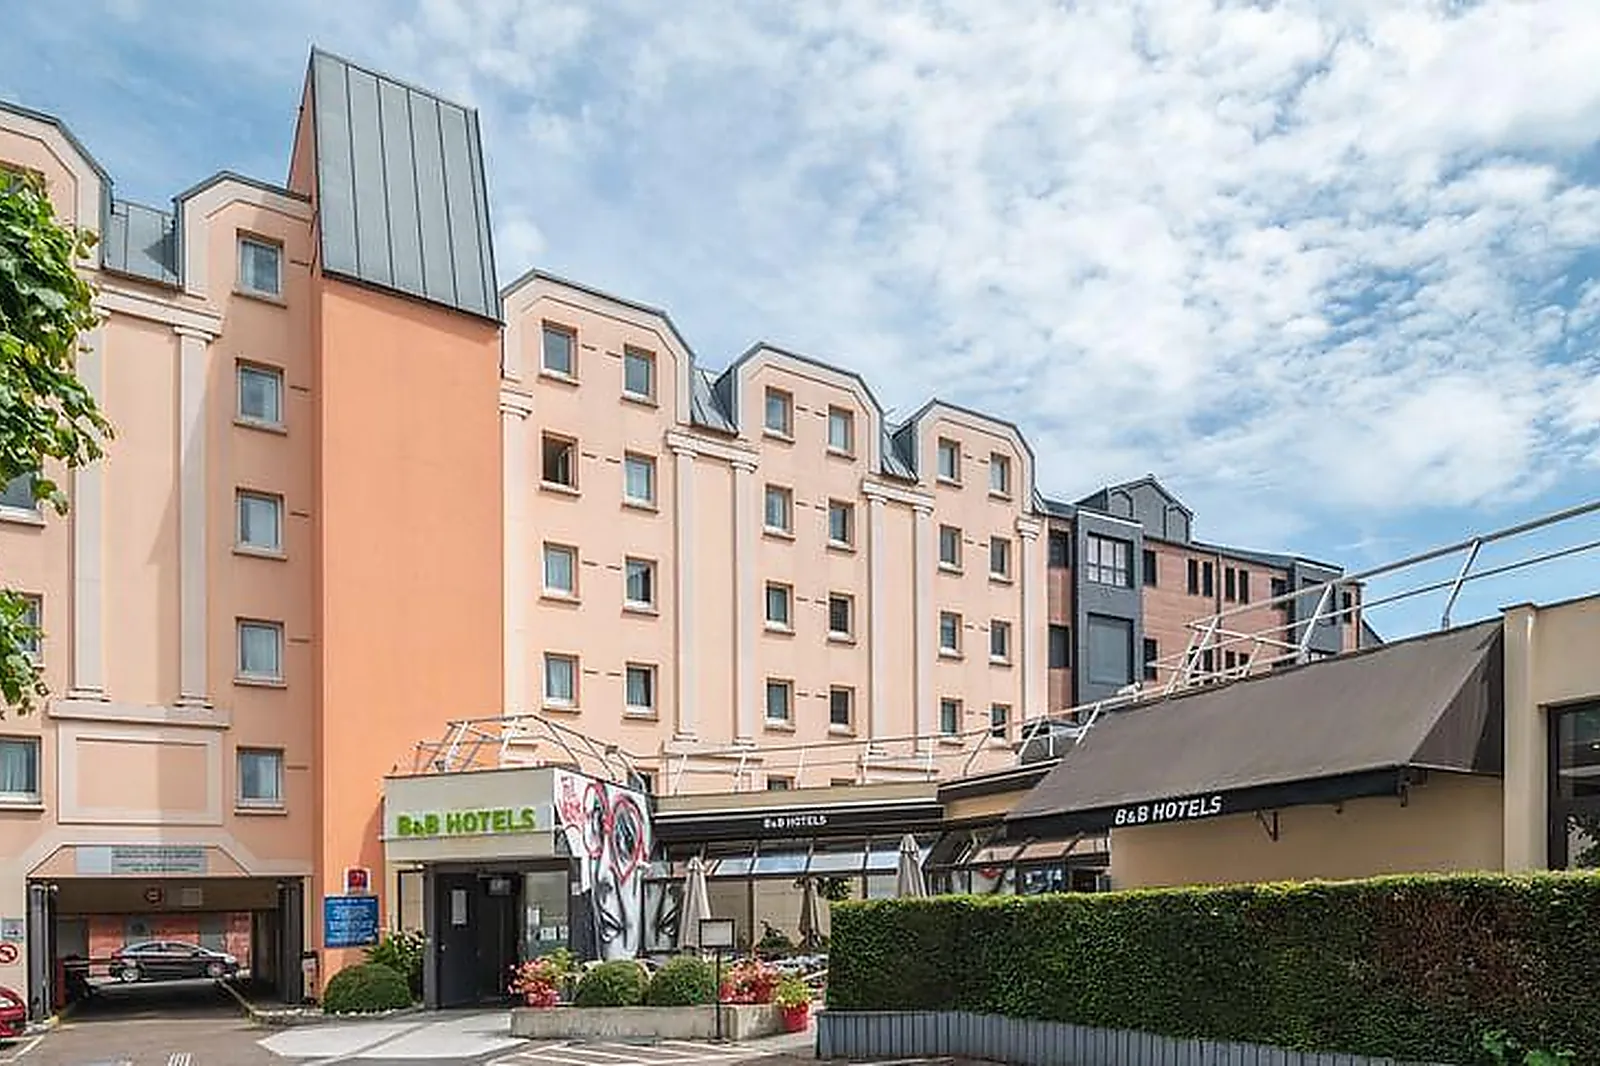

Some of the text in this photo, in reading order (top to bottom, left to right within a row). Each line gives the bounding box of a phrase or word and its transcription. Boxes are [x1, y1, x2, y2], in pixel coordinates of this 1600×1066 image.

[397, 807, 536, 836] B&B HOTELS
[786, 815, 828, 828] HOTELS
[1115, 795, 1222, 825] B&B HOTELS
